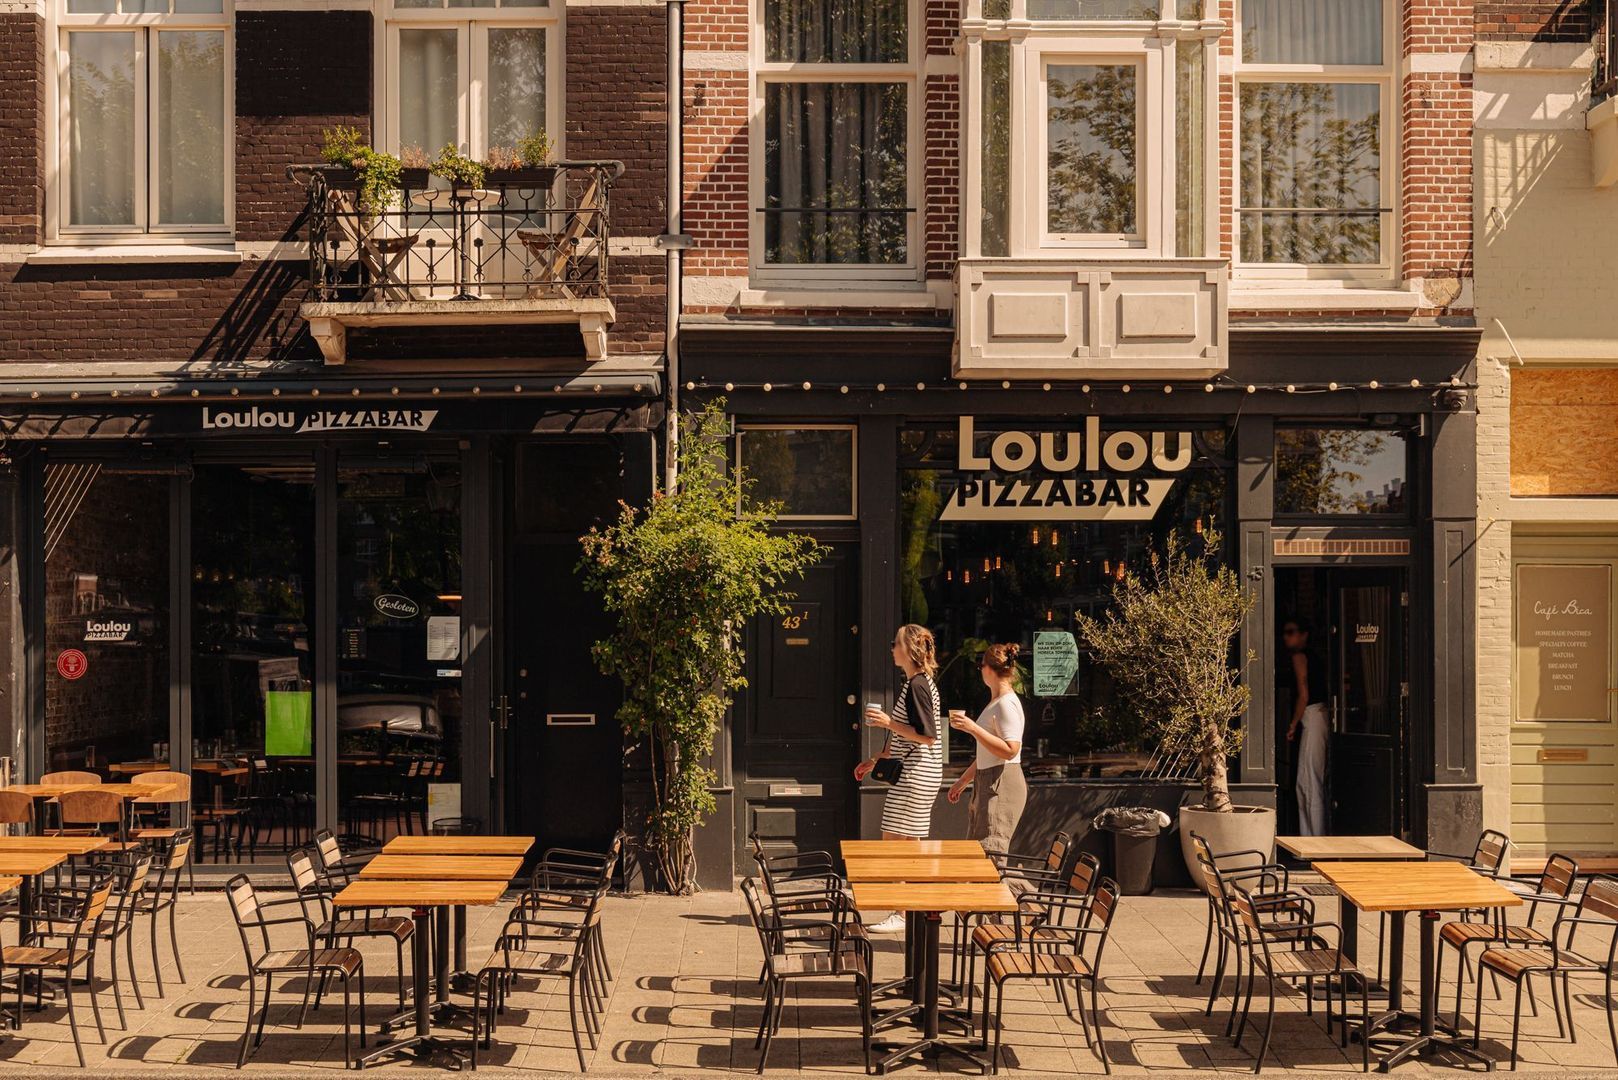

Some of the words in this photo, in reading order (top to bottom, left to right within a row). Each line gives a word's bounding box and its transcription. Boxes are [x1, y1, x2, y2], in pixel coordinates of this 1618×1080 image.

[203, 406, 294, 428] Loulou
[307, 411, 423, 428] PIZZABAR
[959, 416, 1192, 471] Loulou
[957, 479, 1151, 507] PIZZABAR
[378, 598, 416, 613] Gesloten
[1534, 600, 1558, 620] Café
[1561, 599, 1592, 615] Bica
[87, 620, 131, 632] Loulou
[1356, 623, 1379, 634] Loulou
